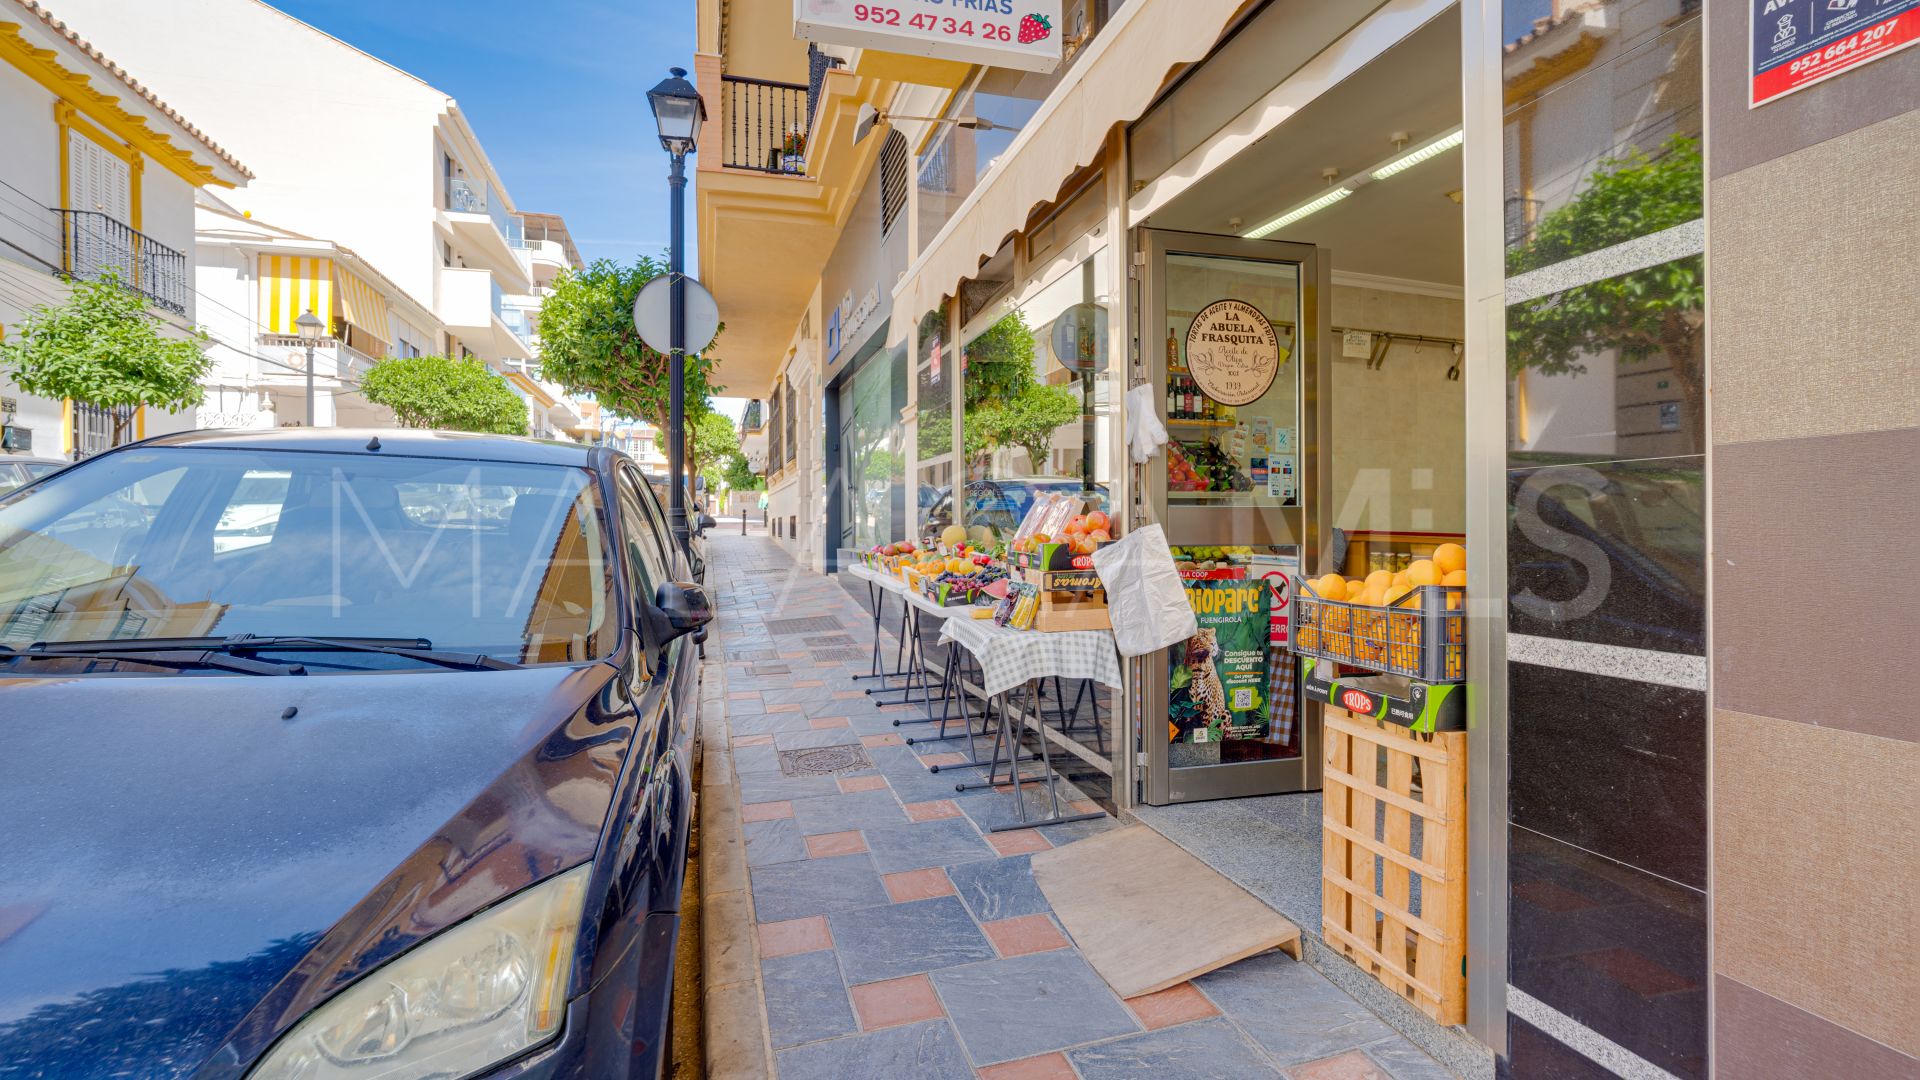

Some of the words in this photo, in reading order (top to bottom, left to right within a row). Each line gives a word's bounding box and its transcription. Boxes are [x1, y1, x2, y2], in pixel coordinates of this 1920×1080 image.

[854, 4, 900, 26] 952
[982, 23, 1011, 42] 26
[1789, 52, 1821, 75] 952
[1824, 36, 1858, 60] 664
[1861, 19, 1899, 45] 207
[1225, 312, 1240, 322] LA
[1189, 319, 1203, 343] TORTAS
[1200, 312, 1209, 322] DE
[1209, 303, 1227, 315] ACEITE
[1233, 303, 1267, 326] ALMENDRAS
[1263, 325, 1276, 347] FRITAS
[1210, 322, 1255, 333] ABUELA
[1201, 333, 1264, 346] FRASQUITA
[1200, 616, 1242, 624] FUENGIROLA
[1270, 624, 1288, 634] ERR
[1223, 656, 1264, 664] DESCUENTO
[1235, 662, 1253, 671] AQUÍ
[1344, 692, 1372, 711] TROPS
